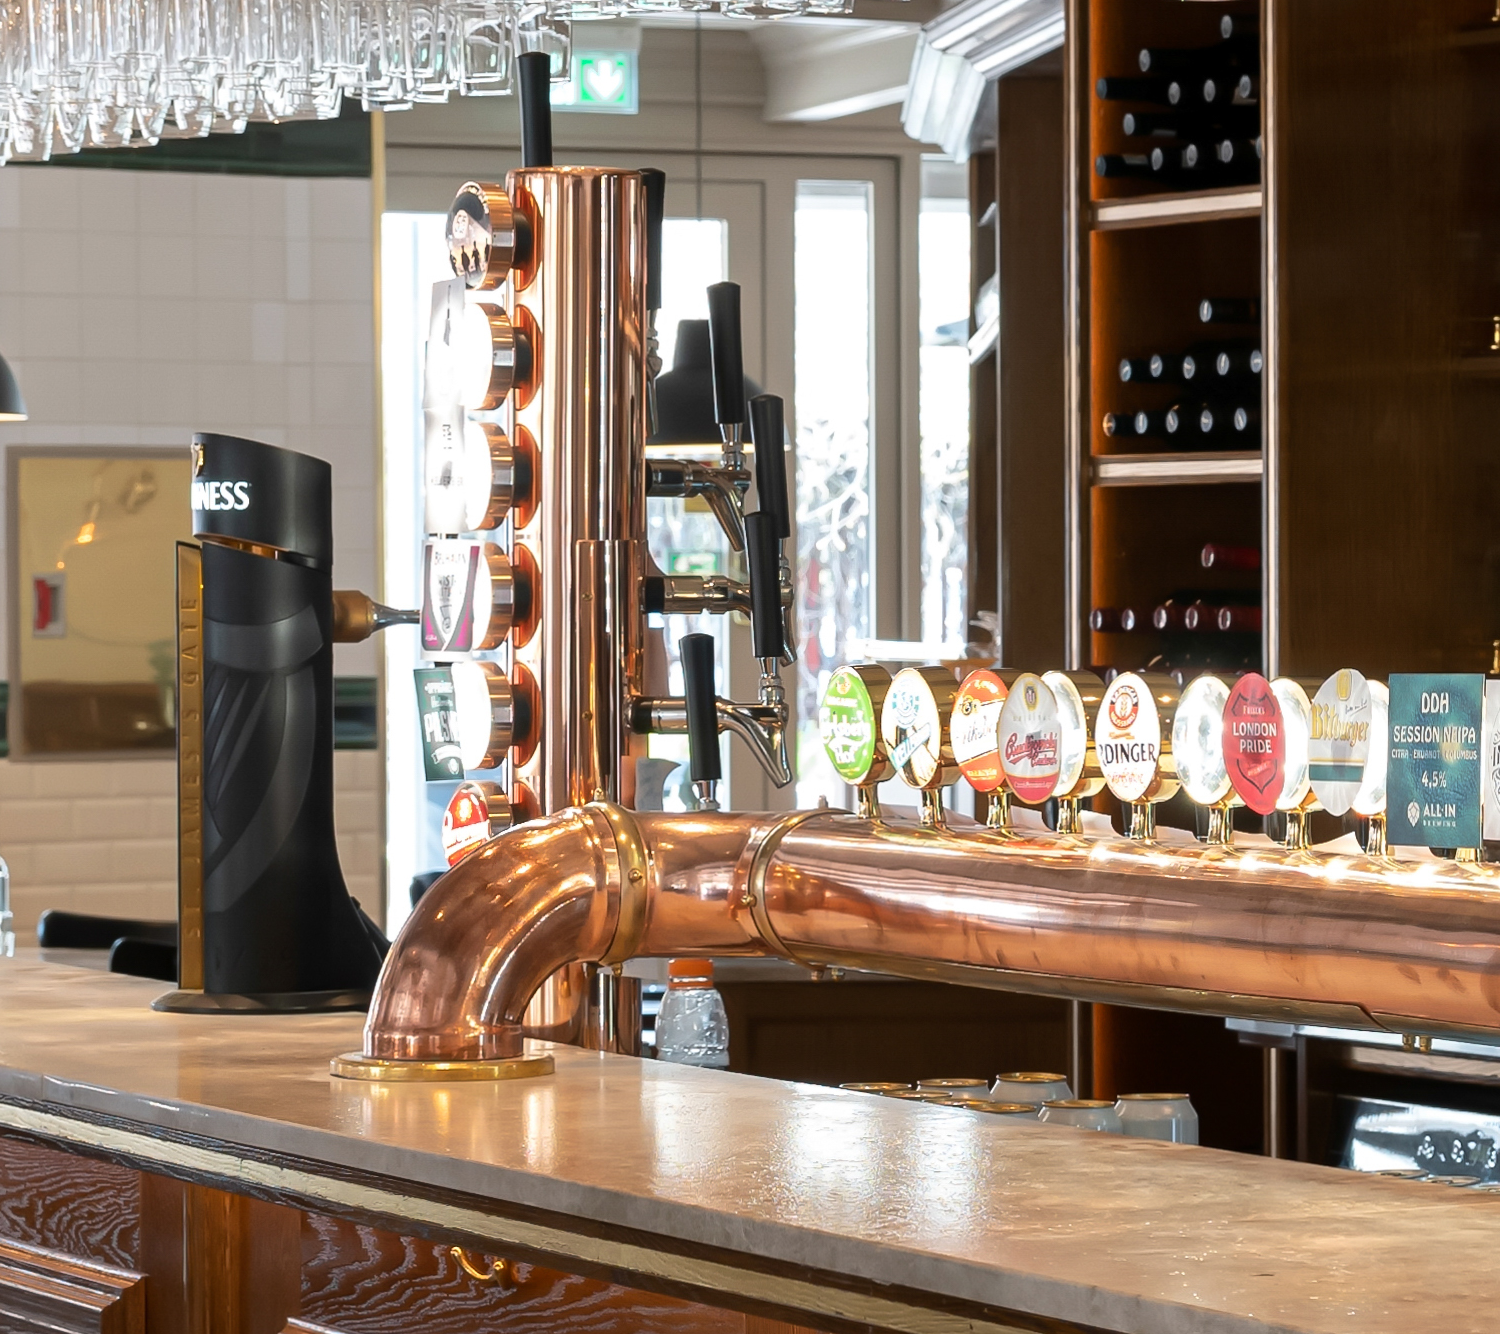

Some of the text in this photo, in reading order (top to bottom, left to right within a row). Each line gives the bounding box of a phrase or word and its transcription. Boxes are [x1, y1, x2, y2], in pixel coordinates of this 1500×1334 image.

[1421, 692, 1450, 714] DDH
[1232, 722, 1278, 737] LONDON
[1393, 725, 1440, 744] SESSION
[1239, 739, 1273, 754] PRIDE
[1391, 749, 1409, 759] CITRA
